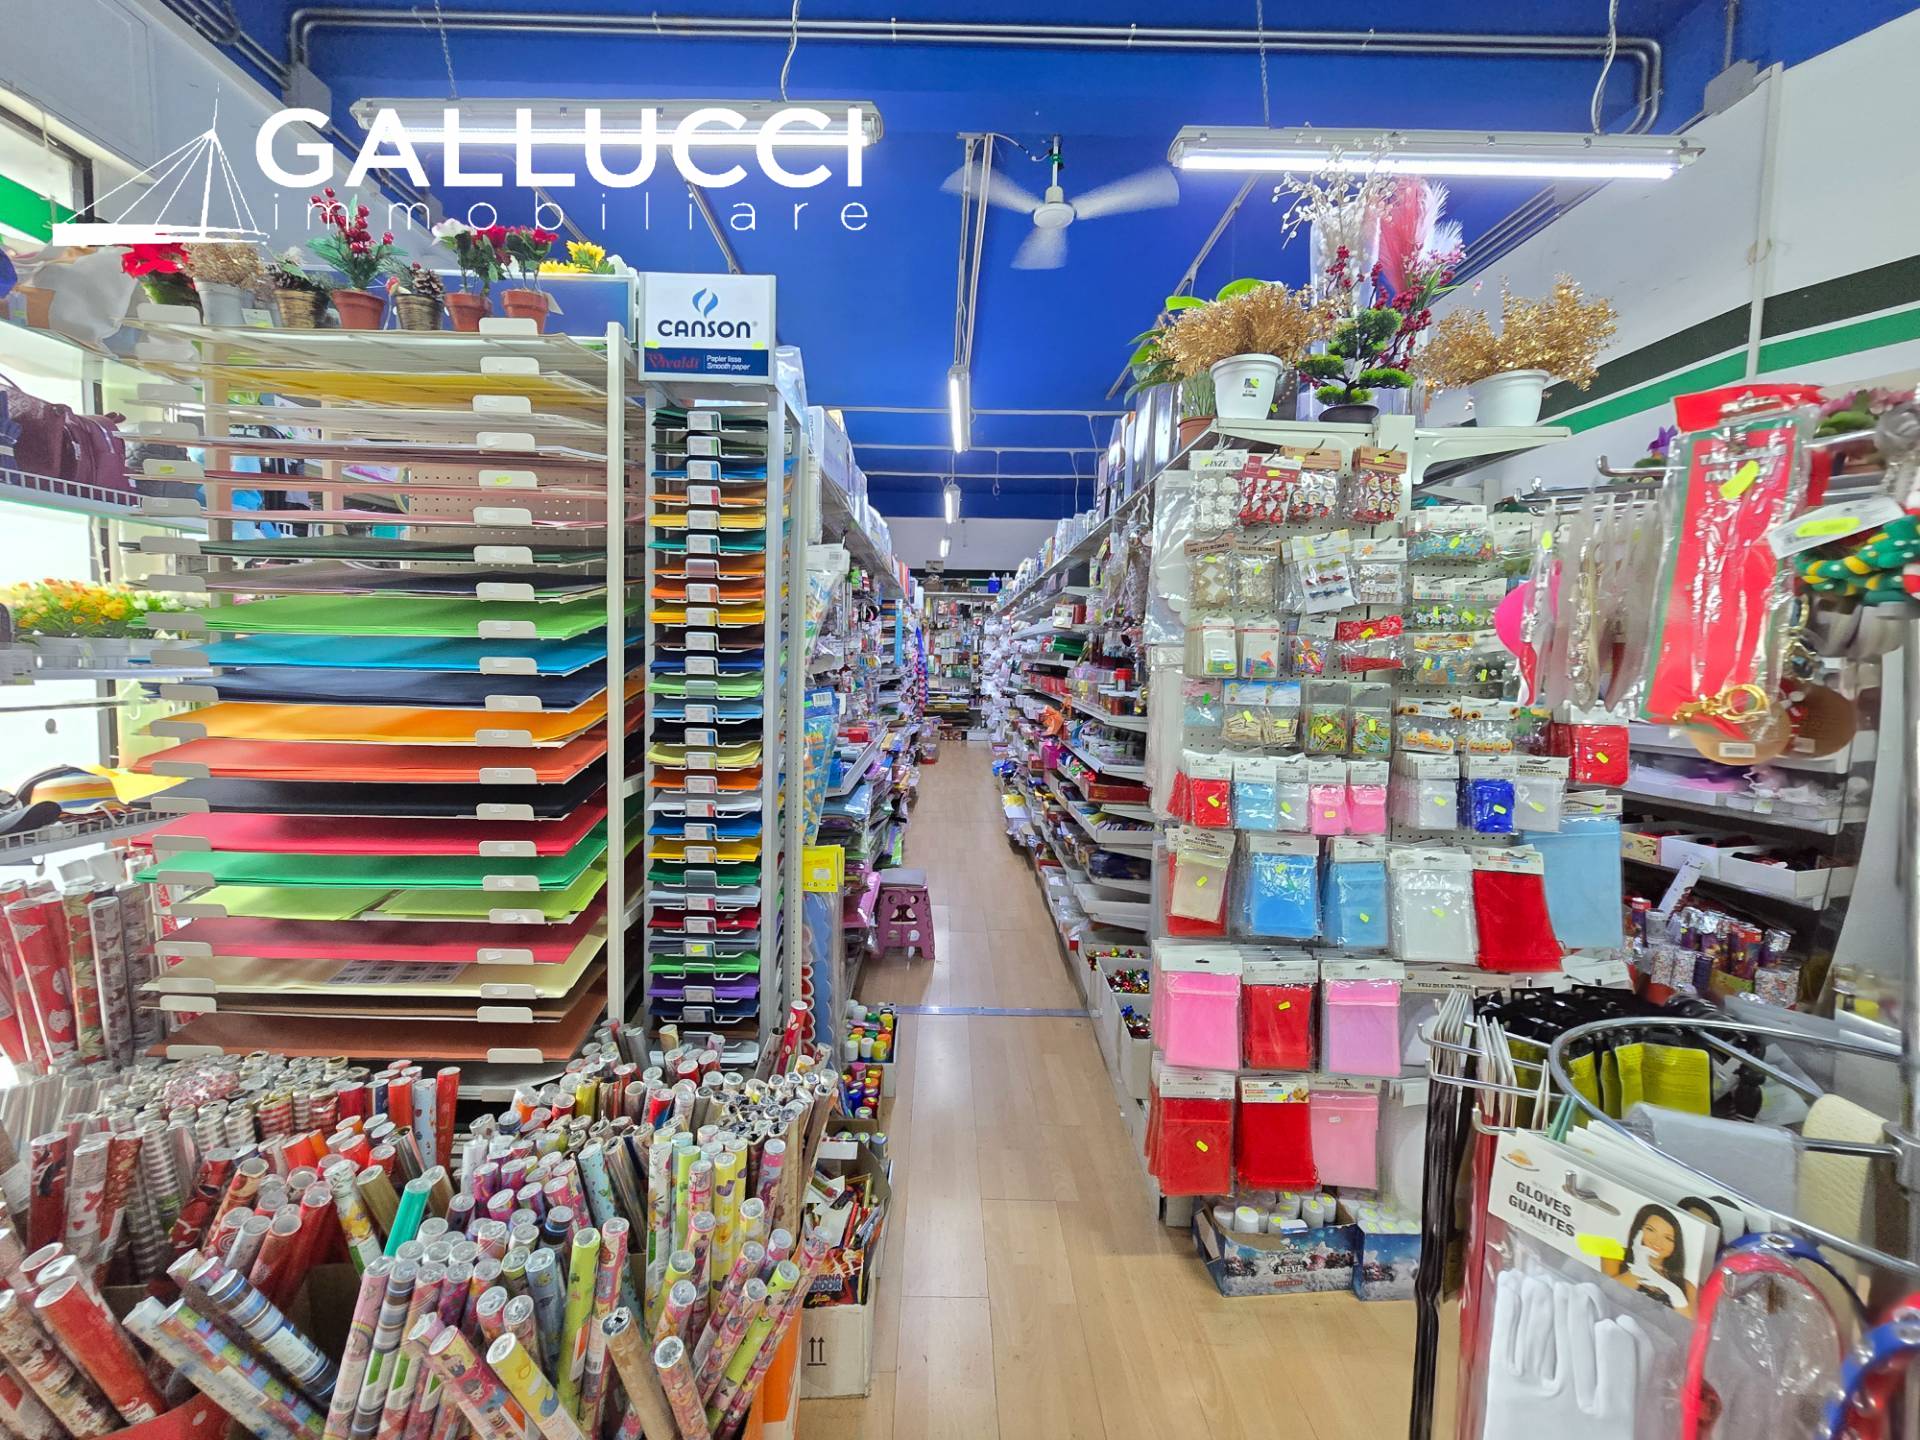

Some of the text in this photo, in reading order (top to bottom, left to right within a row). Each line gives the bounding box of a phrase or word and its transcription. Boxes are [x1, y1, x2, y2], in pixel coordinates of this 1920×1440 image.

[657, 319, 751, 339] CANSON
[646, 351, 701, 370] Vivaldi
[706, 354, 742, 364] Papier lisse
[706, 362, 751, 371] Smooth paper
[1516, 1181, 1572, 1218] GLOVES
[1508, 1194, 1576, 1237] GUANTES
